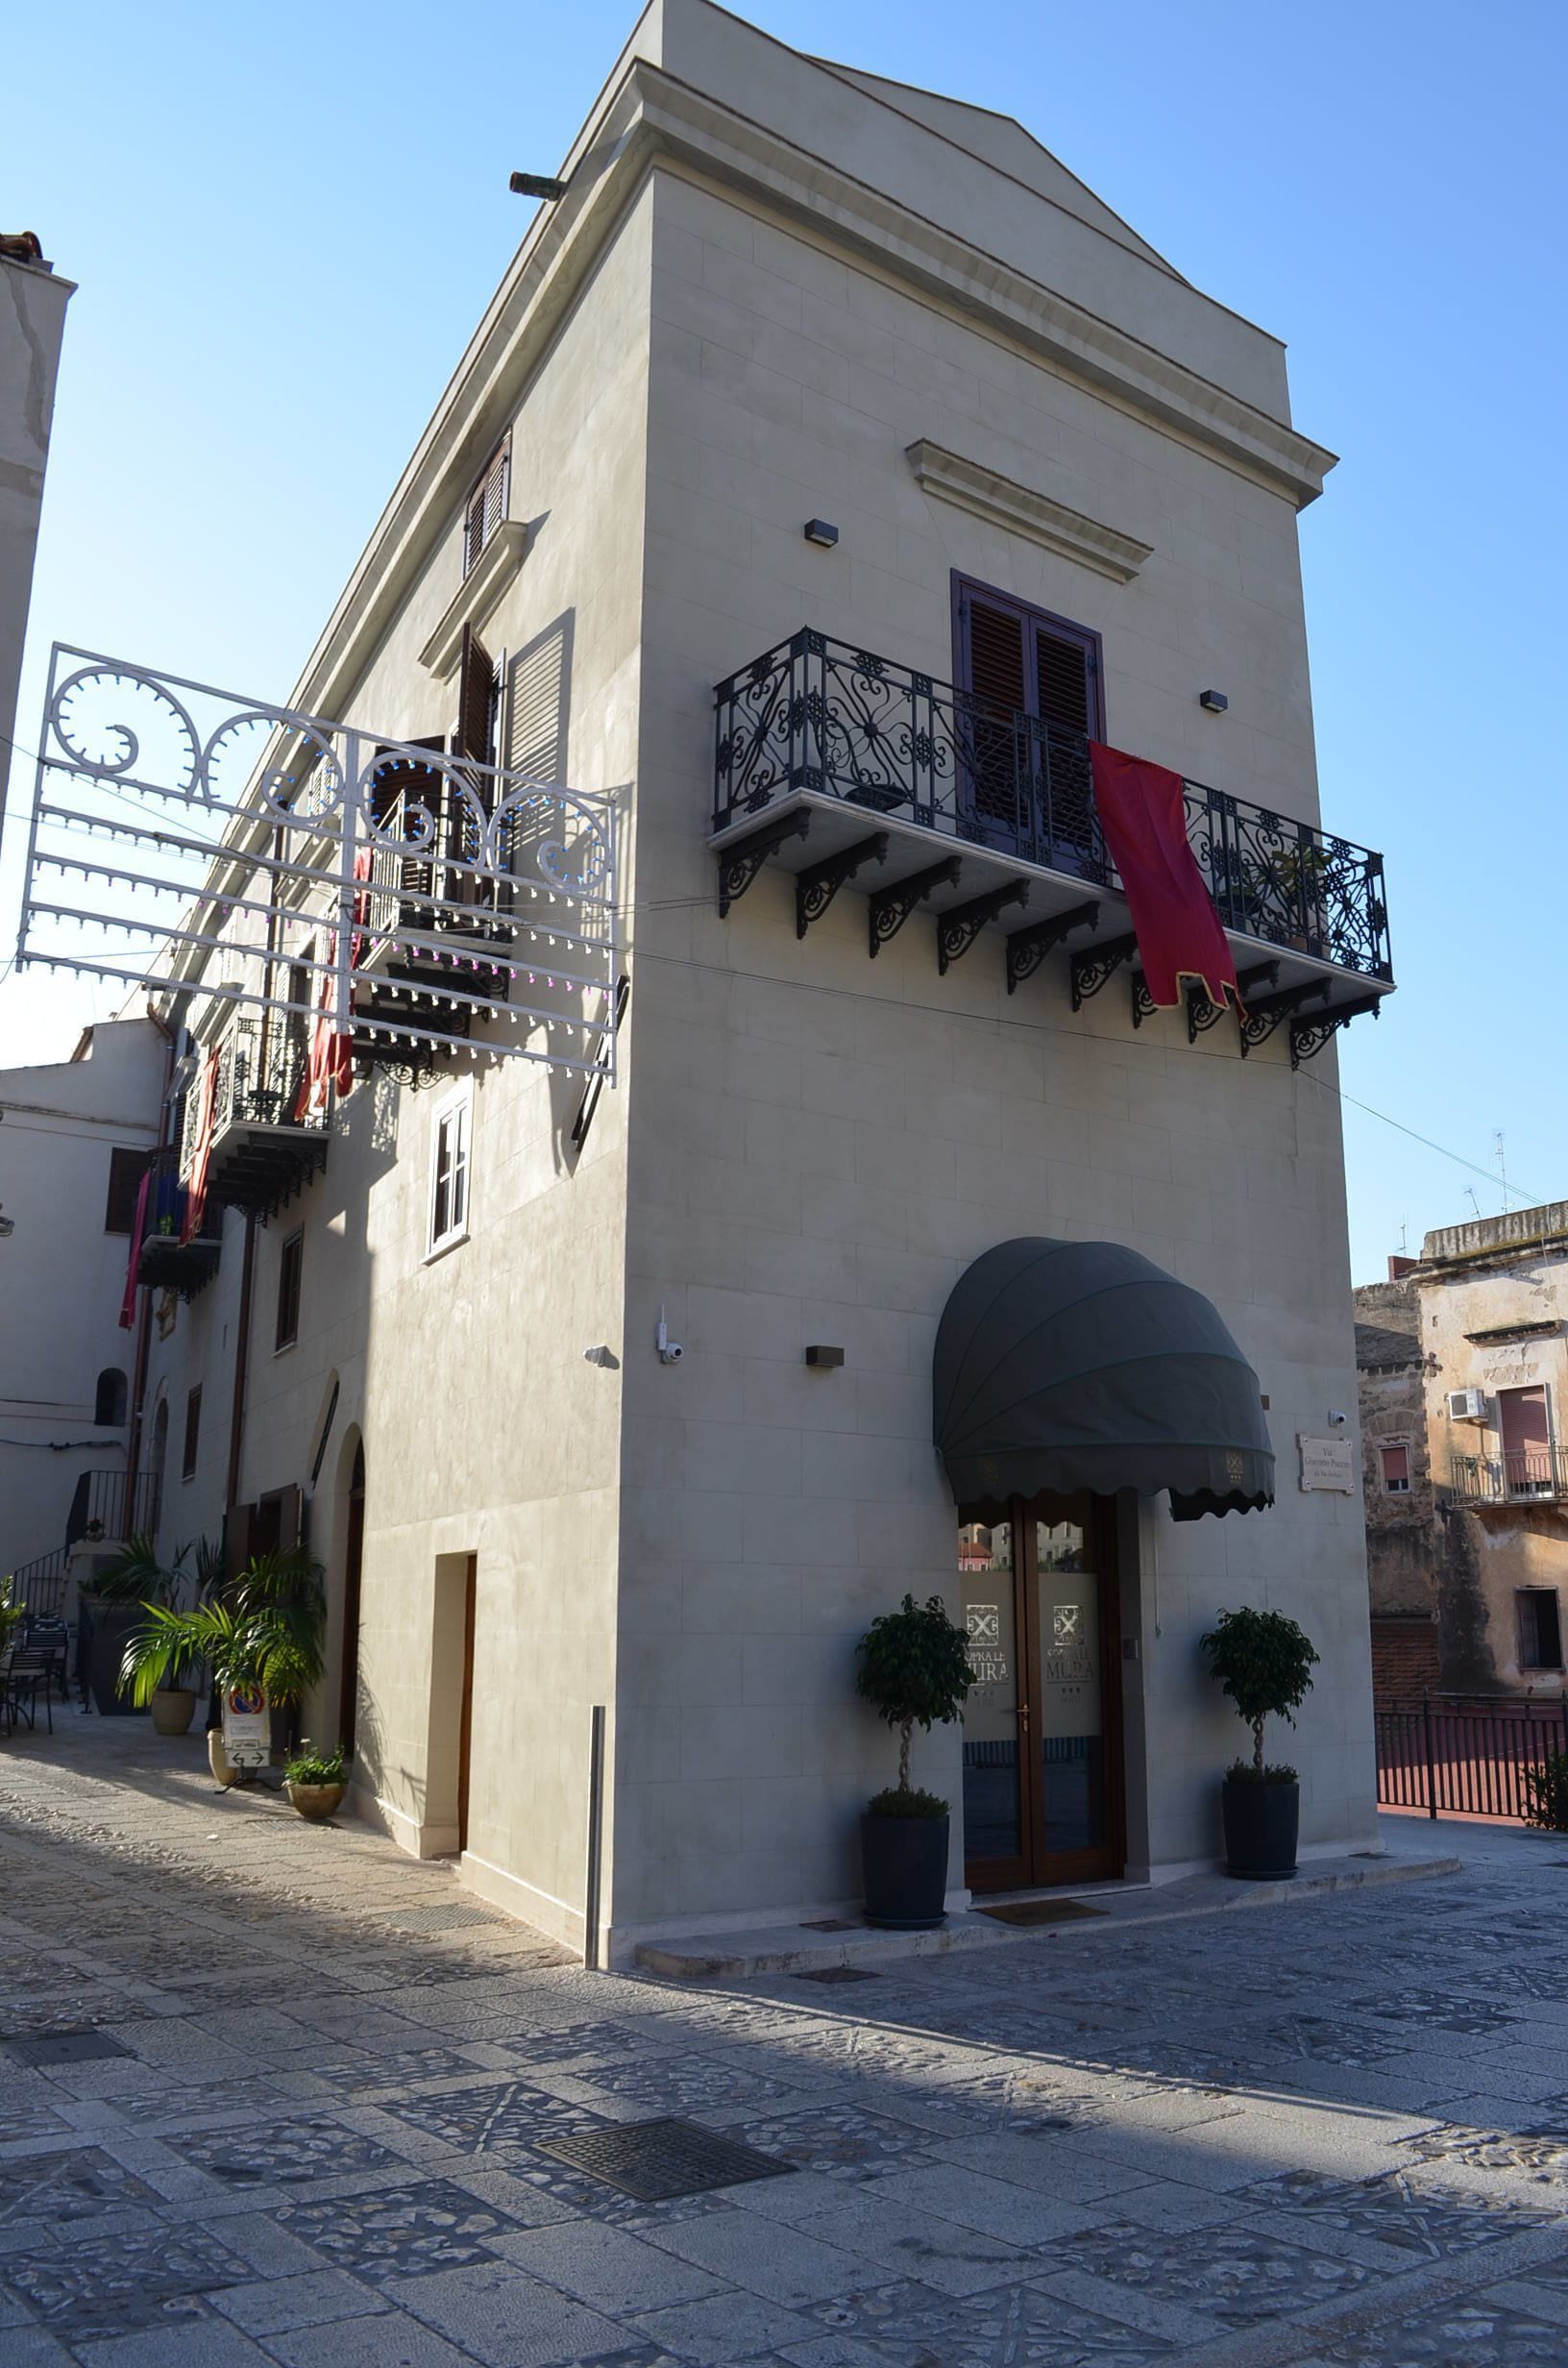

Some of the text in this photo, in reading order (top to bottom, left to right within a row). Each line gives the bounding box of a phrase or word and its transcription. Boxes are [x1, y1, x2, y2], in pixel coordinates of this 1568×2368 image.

[1322, 1446, 1334, 1456] Via
[964, 1651, 1006, 1662] OPRA LE
[968, 1662, 1009, 1681] URA
[1046, 1660, 1095, 1680] MURA
